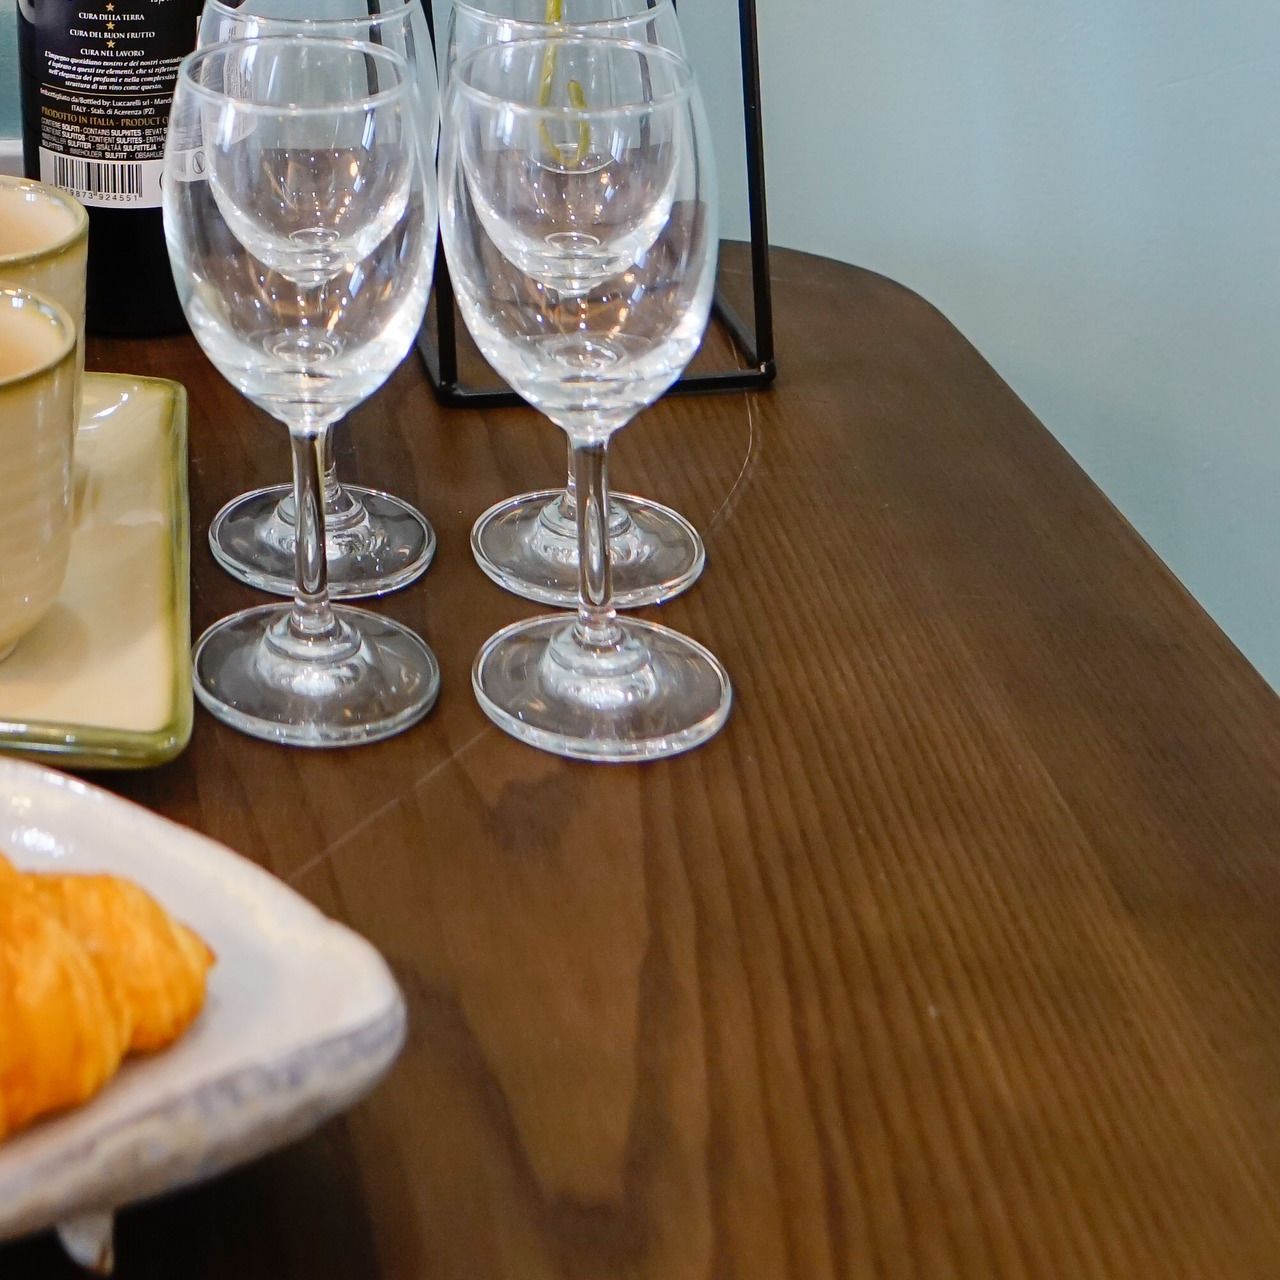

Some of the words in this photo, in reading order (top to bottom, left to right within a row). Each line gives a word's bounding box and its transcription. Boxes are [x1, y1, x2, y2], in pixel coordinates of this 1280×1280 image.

[78, 12, 98, 20] CURA
[70, 29, 88, 37] CURA
[89, 31, 103, 39] DEL
[126, 31, 155, 39] FRUTTO
[80, 48, 99, 56] CURA
[71, 105, 87, 113] ITALY
[41, 106, 77, 122] PRODOTTO
[79, 115, 88, 124] IN
[89, 116, 114, 126] ITALIA
[121, 117, 160, 127] PRODUCT
